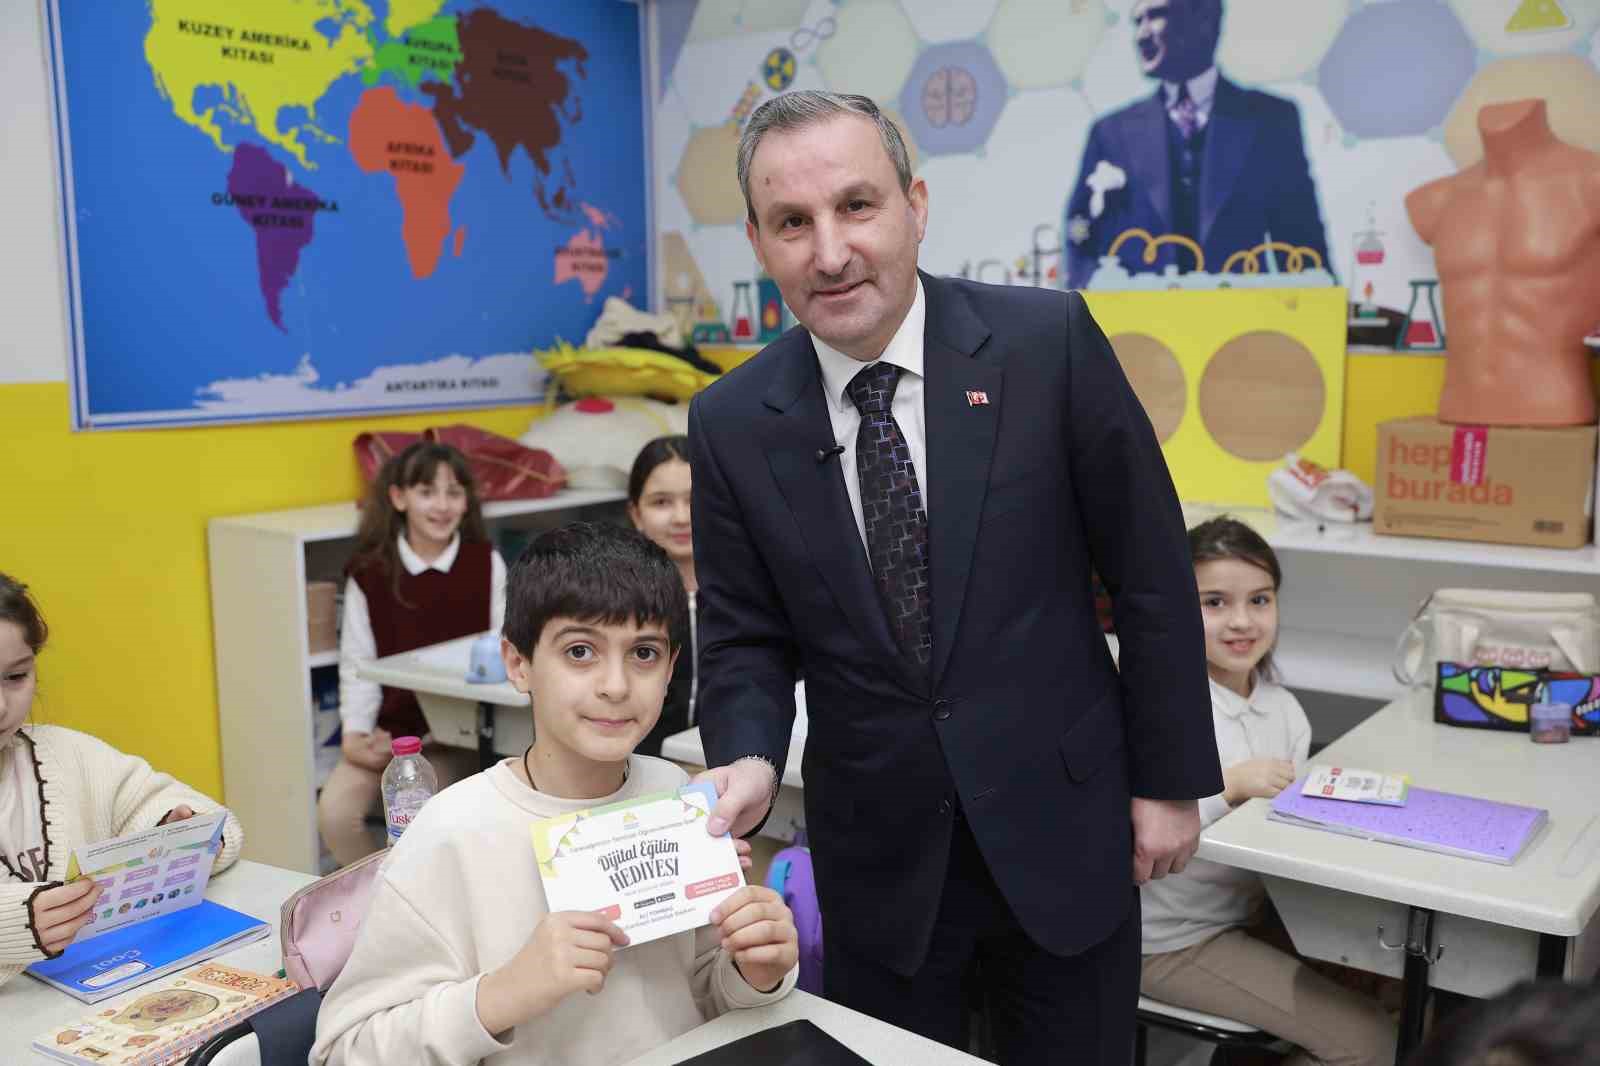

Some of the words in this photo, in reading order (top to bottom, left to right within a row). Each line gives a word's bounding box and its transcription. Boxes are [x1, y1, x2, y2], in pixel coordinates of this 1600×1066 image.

[178, 19, 233, 41] KUZEY
[221, 46, 274, 65] KITASI
[1388, 436, 1450, 472] hep
[1386, 470, 1512, 504] burada
[598, 844, 638, 872] Dijital
